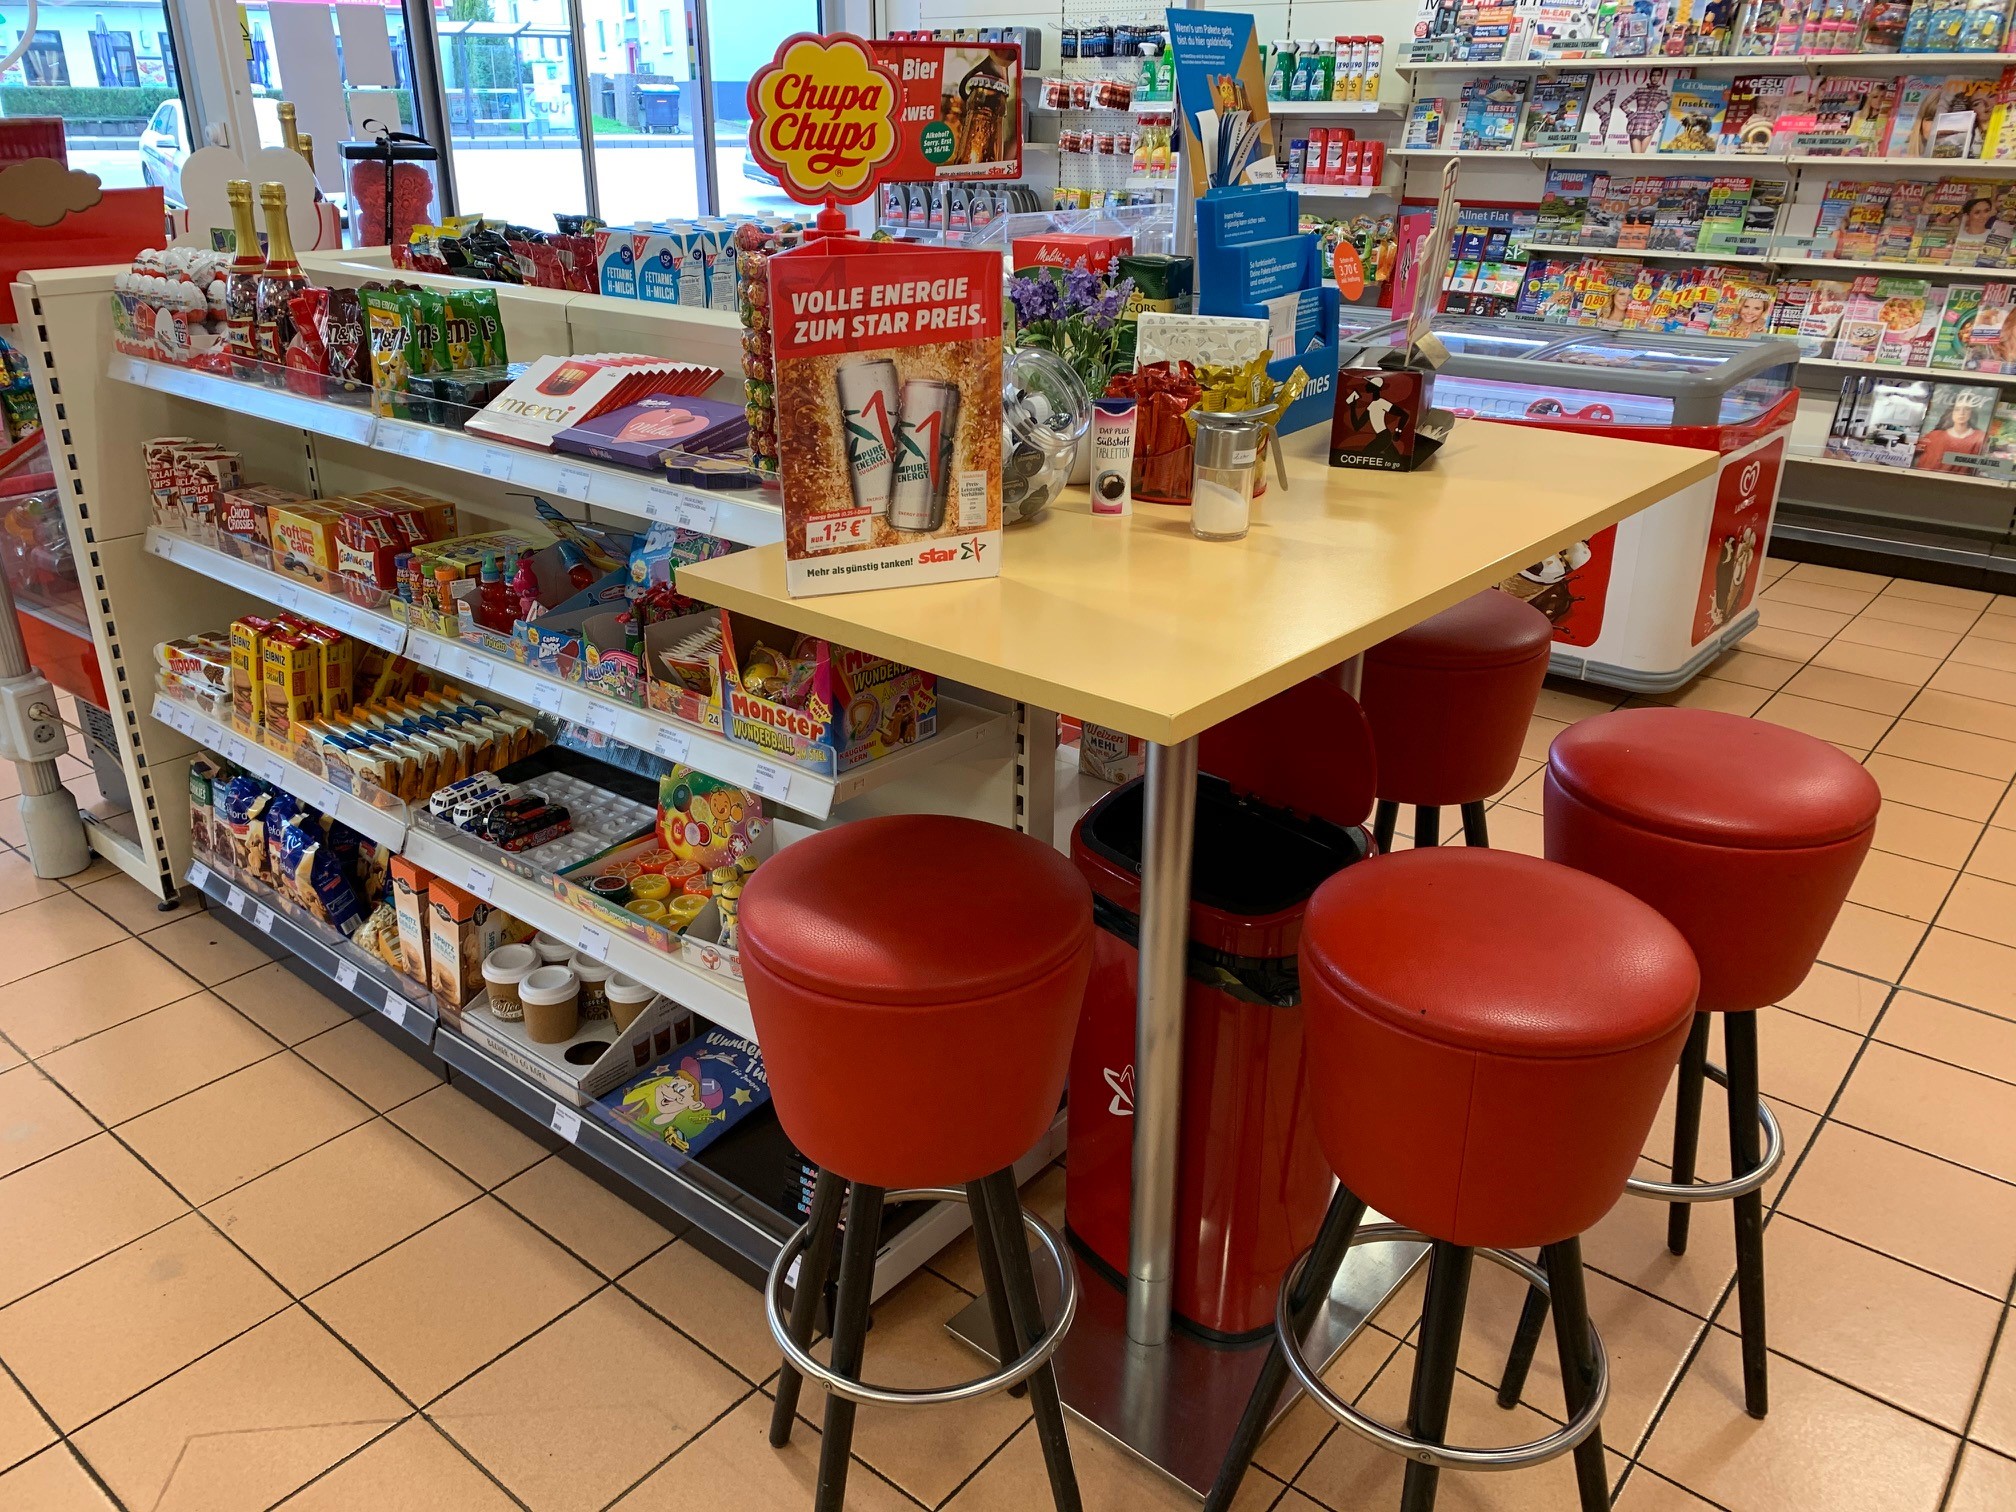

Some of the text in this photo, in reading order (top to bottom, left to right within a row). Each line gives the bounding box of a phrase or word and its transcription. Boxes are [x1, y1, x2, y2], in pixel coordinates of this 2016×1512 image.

[902, 57, 939, 80] Bier
[1624, 68, 1691, 85] VOUE
[1556, 74, 1588, 84] PREISE
[1749, 78, 1784, 88] GESU
[774, 73, 883, 121] Chupa
[1678, 98, 1721, 109] Insekten
[770, 111, 879, 168] Chups
[925, 130, 950, 139] Alkohol?
[923, 139, 940, 147] Sorry.
[925, 145, 950, 154] ab 16/18.
[988, 165, 1006, 175] star
[1550, 170, 1588, 184] Camper
[1895, 184, 1924, 197] Adel
[1941, 183, 1968, 194] ADEL
[1458, 208, 1510, 222] Allnet Flat
[1797, 239, 1814, 247] SPORT
[1033, 244, 1064, 264] Melitta
[606, 266, 634, 282] FETTARME
[1353, 263, 1359, 274] €
[644, 270, 674, 286] FETTARME
[607, 280, 635, 296] H-MILCH
[645, 284, 675, 301] H-MILCH
[791, 276, 969, 316] VOLLE ENERGIE
[1446, 306, 1466, 314] amazon
[793, 303, 987, 344] ZUM STAR PREIS.
[497, 394, 576, 423] merci
[629, 421, 674, 437] Milka
[1099, 427, 1130, 435] DAY PLUS
[1096, 435, 1130, 447] Süßstoff
[861, 443, 885, 460] PURE
[1095, 446, 1131, 459] TABLETTEN
[855, 451, 888, 471] ENERGY
[858, 458, 892, 476] SUGARFREE
[905, 462, 929, 474] PURE
[1340, 454, 1384, 467] COFFEE
[1391, 462, 1401, 470] go
[897, 470, 930, 483] ENERGY
[230, 505, 250, 519] CHOCO
[808, 514, 826, 522] Energy
[227, 516, 255, 531] CROSSIES
[279, 523, 301, 540] soft
[810, 536, 824, 544] NUR
[823, 521, 847, 543] 1,25
[290, 536, 315, 557] cake
[806, 547, 958, 577] Mehr als günstig tanken! star
[231, 631, 251, 651] LEIBNIZ
[263, 646, 286, 667] LEIBNIZ
[538, 642, 561, 659] DIPS
[169, 656, 202, 675] nippon
[852, 661, 916, 694] WUNDERB
[730, 690, 826, 742] Monster
[811, 707, 822, 719] MIX
[812, 697, 831, 719] FRUITY
[708, 713, 720, 725] 24
[732, 717, 796, 756] WUNDERBALL
[1085, 723, 1126, 744] Weizen
[838, 739, 878, 760] KAUGUMMI
[1091, 736, 1118, 753] MEHL
[796, 747, 807, 760] AM
[849, 751, 868, 765] KERN
[398, 910, 417, 927] SPRITZ
[433, 932, 455, 953] SPRITZ
[492, 998, 521, 1013] Coffee
